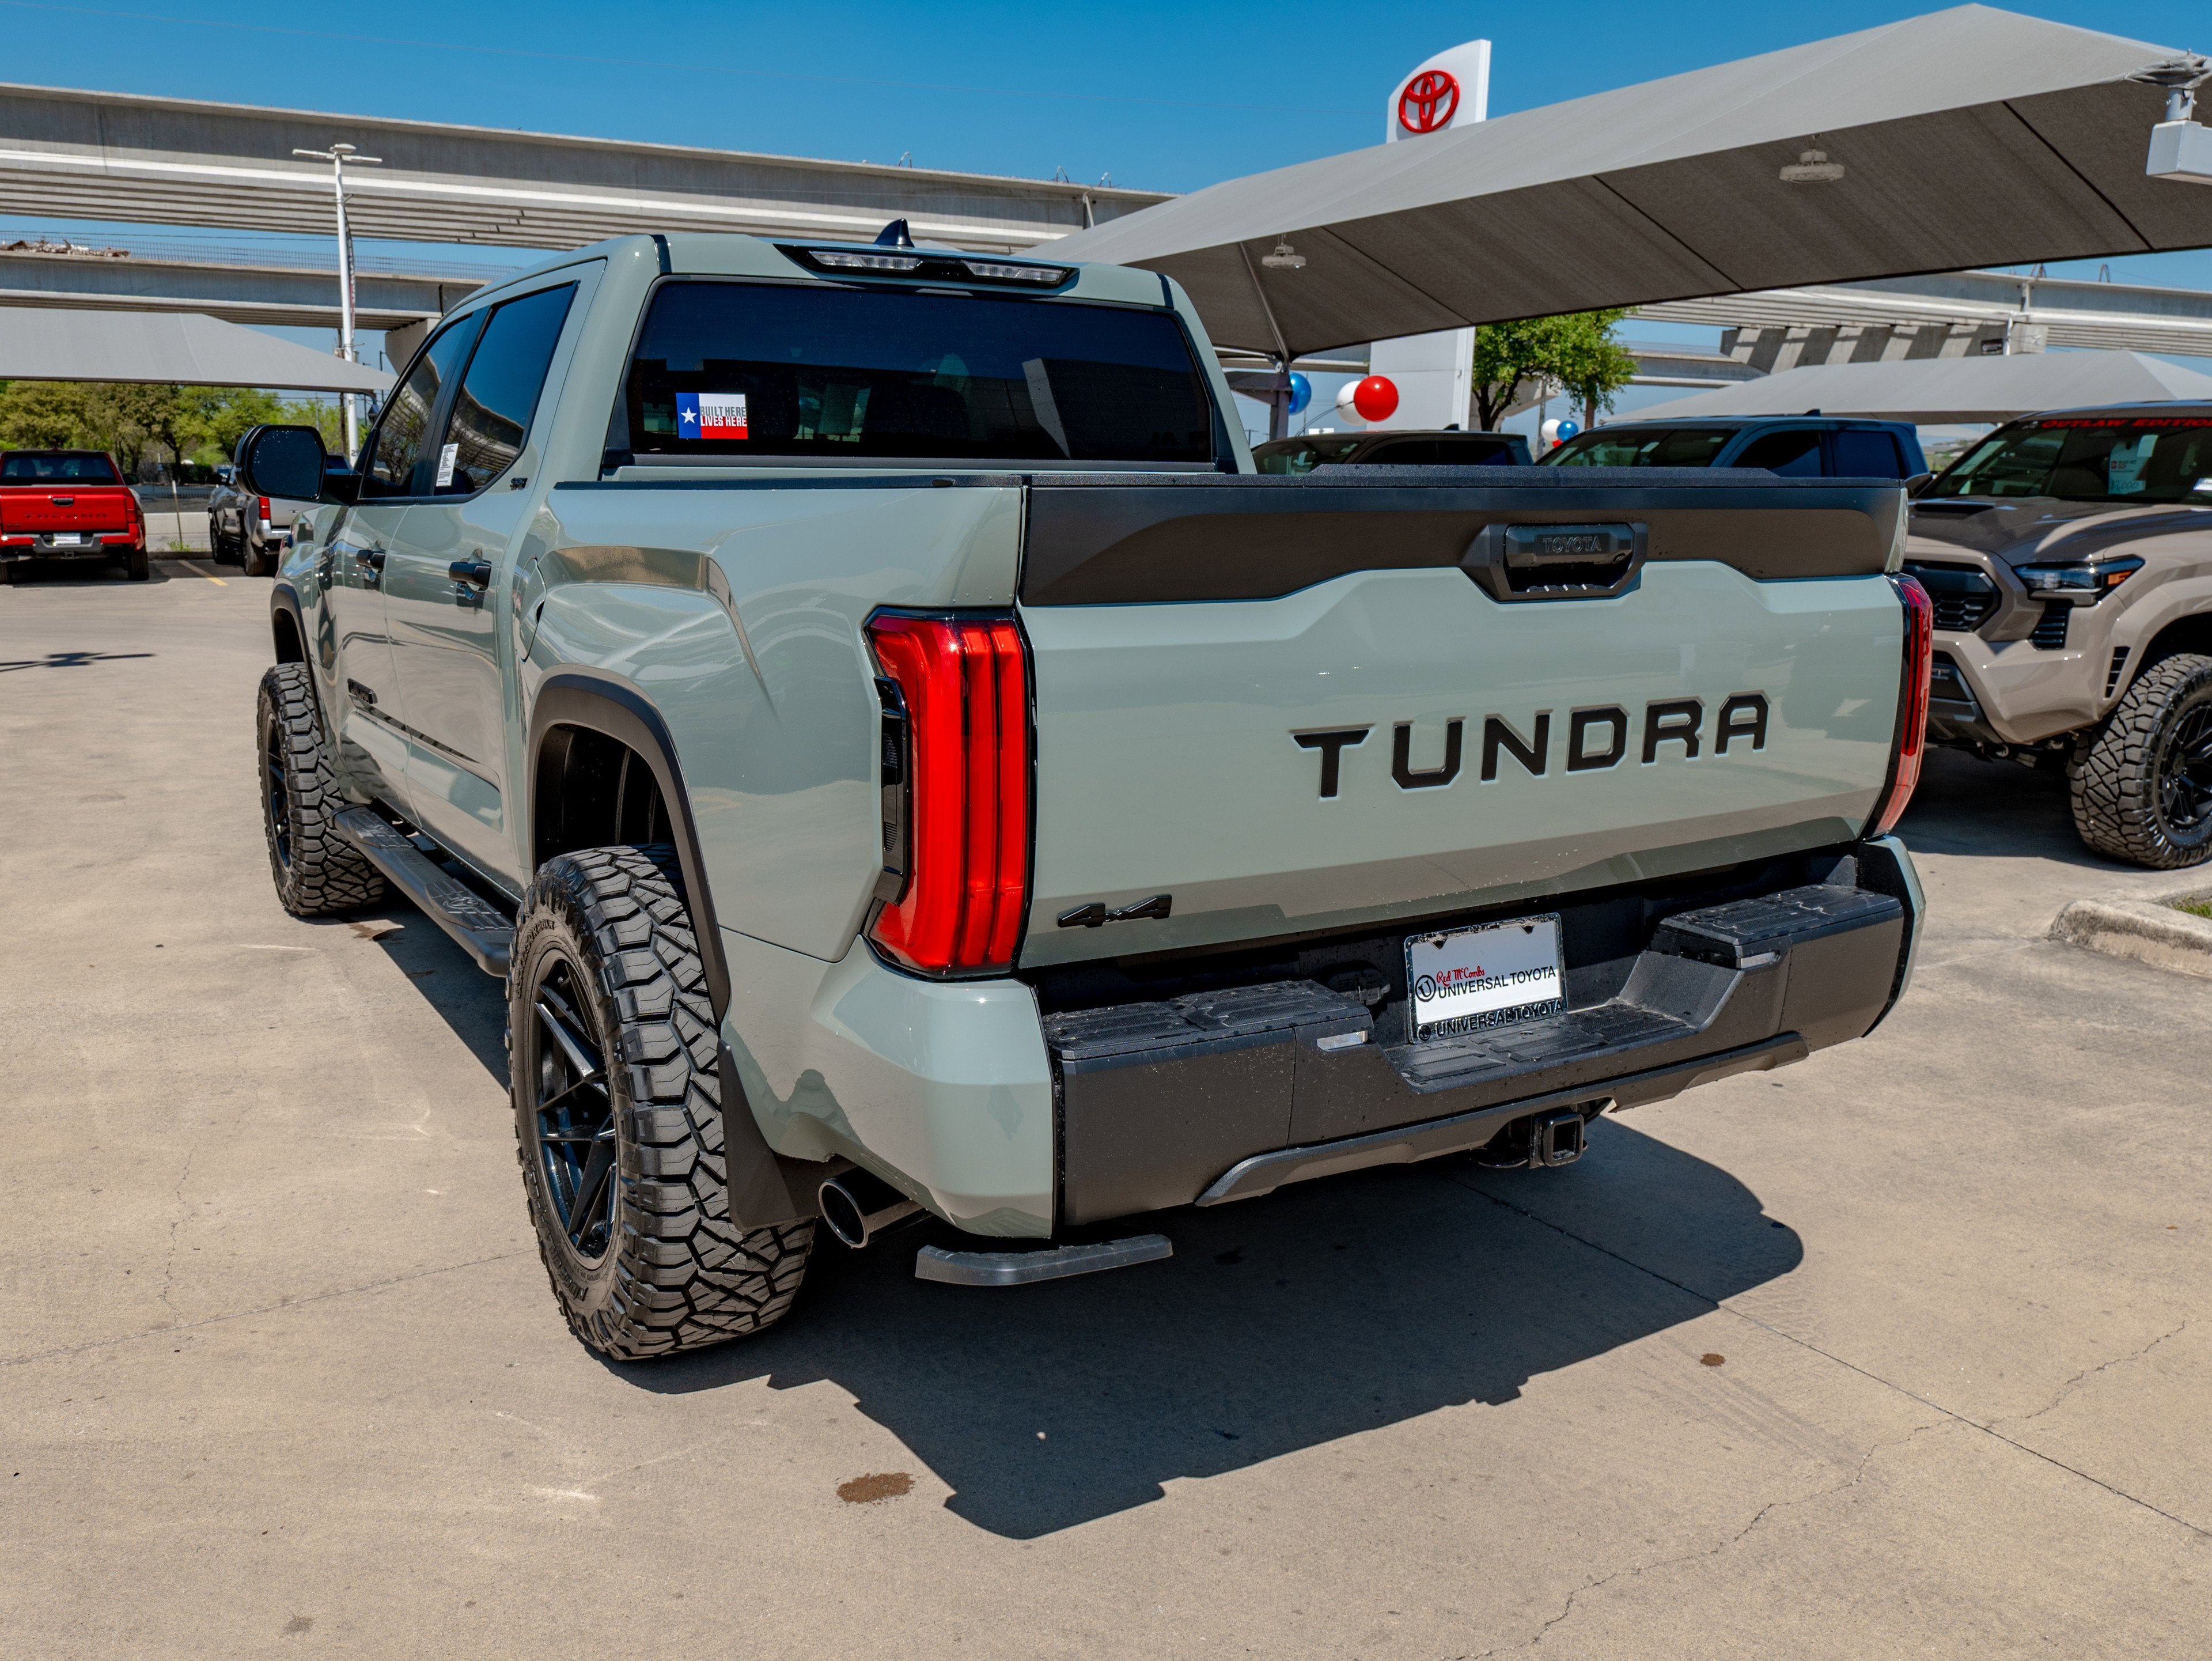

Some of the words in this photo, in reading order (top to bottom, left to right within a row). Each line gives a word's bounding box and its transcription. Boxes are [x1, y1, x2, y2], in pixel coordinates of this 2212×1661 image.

[700, 406, 723, 417] BUILT
[725, 407, 746, 417] HERE
[700, 416, 724, 426] LIVES
[725, 417, 747, 426] HERE
[2041, 419, 2128, 428] OUTLAW
[1542, 536, 1601, 554] TOYOTA
[1292, 690, 1771, 800] TUNDRA
[1436, 971, 1451, 987] Red
[1438, 975, 1509, 998] UNIVERSAL
[1510, 966, 1556, 985] TOYOTA
[1435, 1009, 1513, 1036] UNIVERSAL
[1514, 1000, 1563, 1021] TOYOTA
